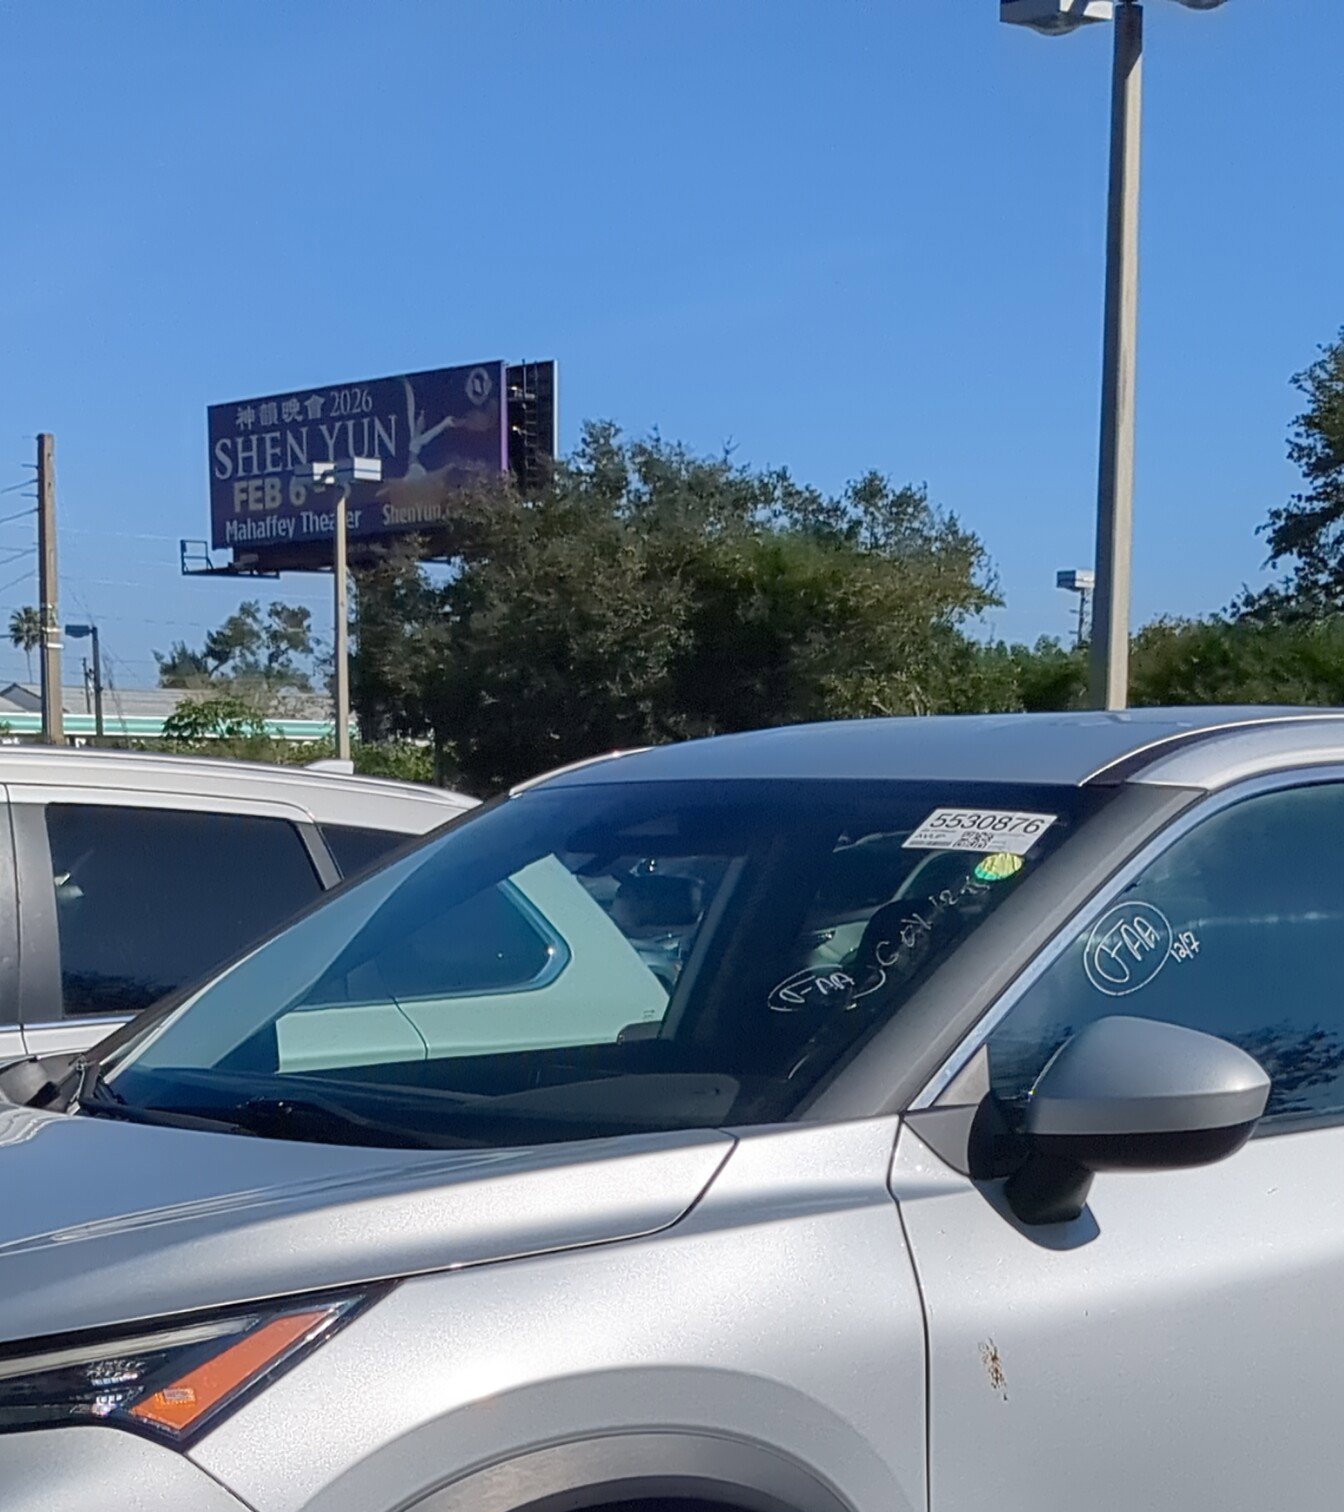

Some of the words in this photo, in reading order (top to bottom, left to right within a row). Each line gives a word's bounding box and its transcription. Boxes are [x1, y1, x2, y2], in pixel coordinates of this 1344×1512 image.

[330, 388, 373, 417] 2026
[214, 427, 308, 480] SHEN
[319, 414, 398, 462] YUN
[233, 477, 281, 513] FEB
[225, 513, 295, 543] Mahaffey
[300, 508, 362, 533] Theaer
[929, 812, 1045, 834] 5530876
